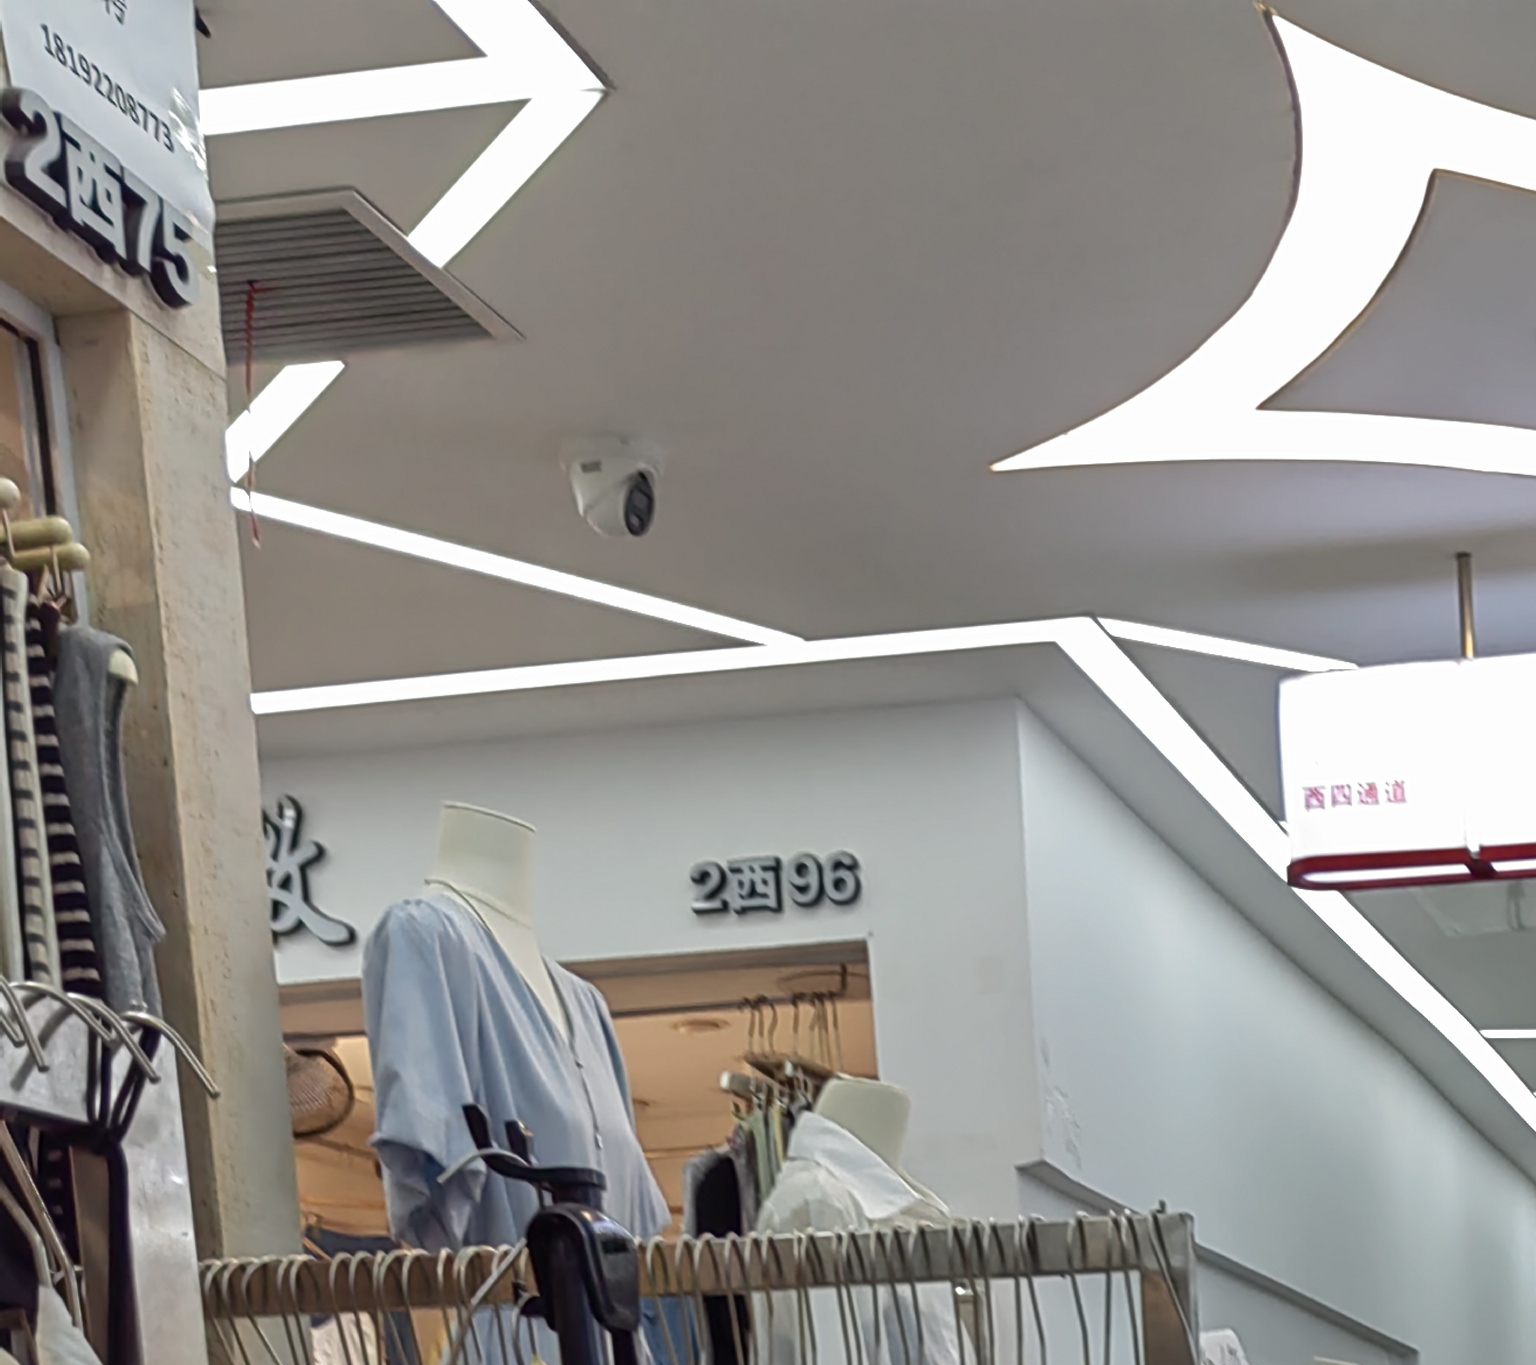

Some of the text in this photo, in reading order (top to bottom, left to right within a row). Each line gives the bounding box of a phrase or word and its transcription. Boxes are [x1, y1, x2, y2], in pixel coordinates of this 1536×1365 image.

[40, 23, 175, 153] 18192208773
[2, 86, 201, 309] 2西75
[1302, 780, 1408, 811] 西四通道
[689, 849, 863, 916] 2西96
